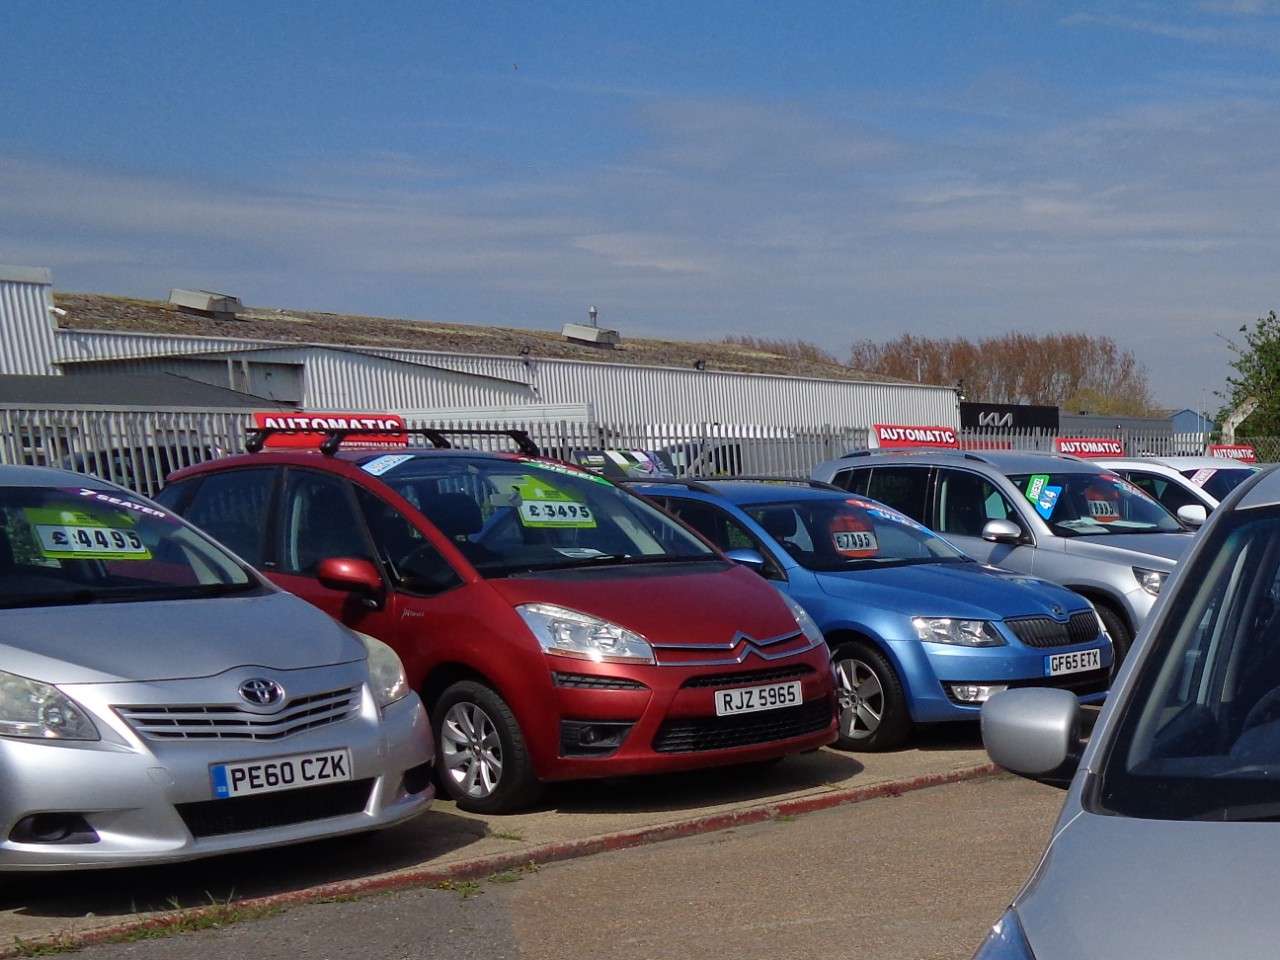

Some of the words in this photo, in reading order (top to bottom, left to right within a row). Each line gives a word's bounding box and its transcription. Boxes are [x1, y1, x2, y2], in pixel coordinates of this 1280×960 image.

[880, 427, 955, 444] AUTOMATIC
[1060, 441, 1121, 454] AUTOMATIC
[1213, 448, 1254, 459] AUTOMATIC
[96, 493, 166, 519] SEATER
[529, 504, 590, 519] £3495
[51, 528, 142, 550] £4495
[1051, 654, 1079, 672] GF65
[1080, 650, 1099, 668] ETX
[723, 690, 755, 712] RJZ
[759, 684, 796, 707] 5965
[230, 760, 295, 792] PE60
[300, 754, 346, 781] CZK
